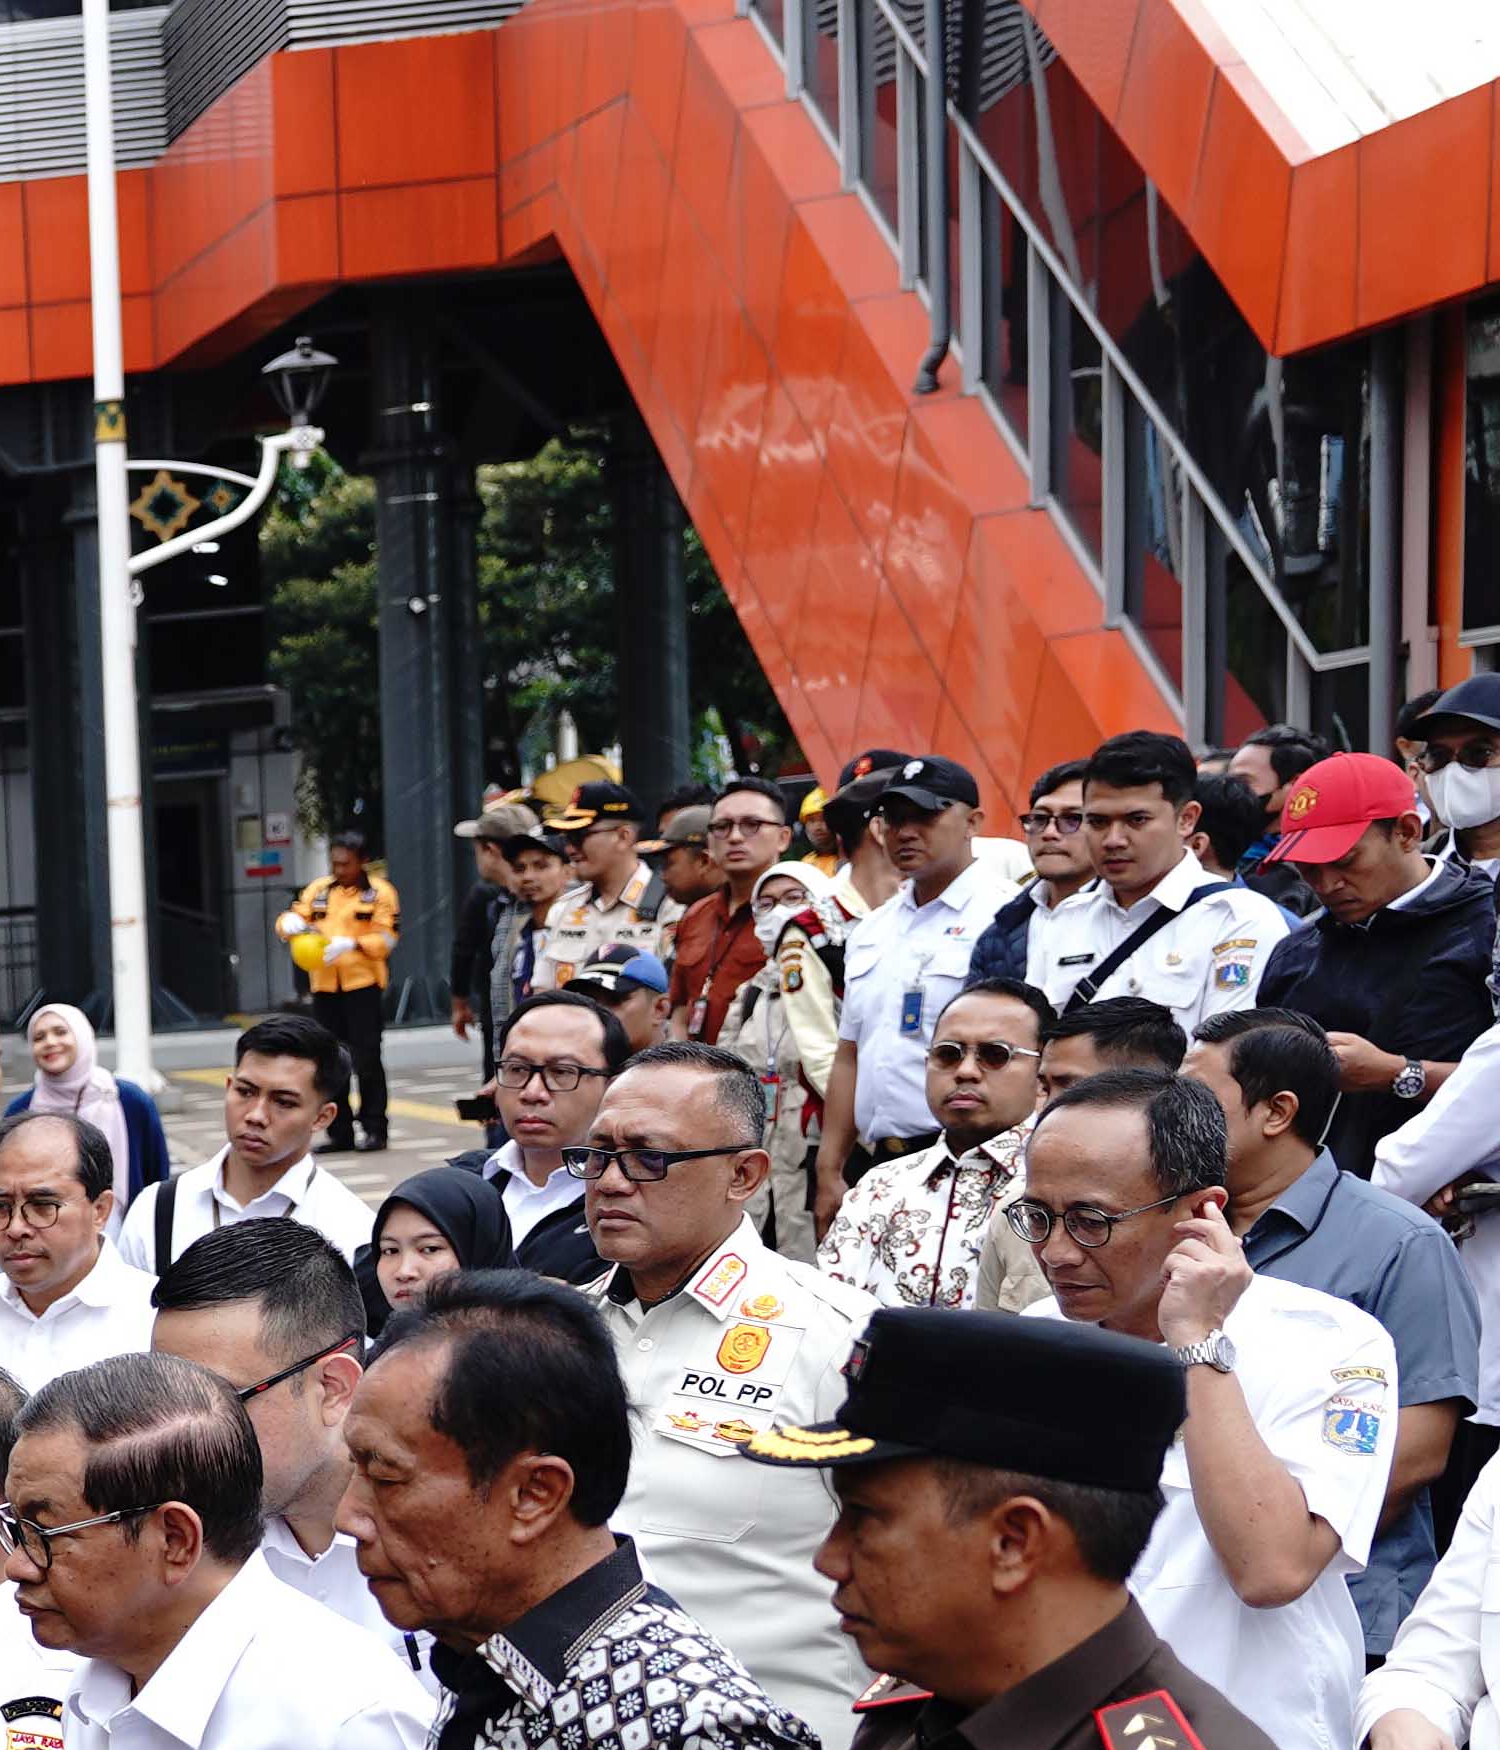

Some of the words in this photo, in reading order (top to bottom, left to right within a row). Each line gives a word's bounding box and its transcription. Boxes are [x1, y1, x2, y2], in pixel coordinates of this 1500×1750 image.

[681, 1373, 728, 1398] POL
[736, 1383, 774, 1405] PP
[12, 1733, 36, 1745] JAYA
